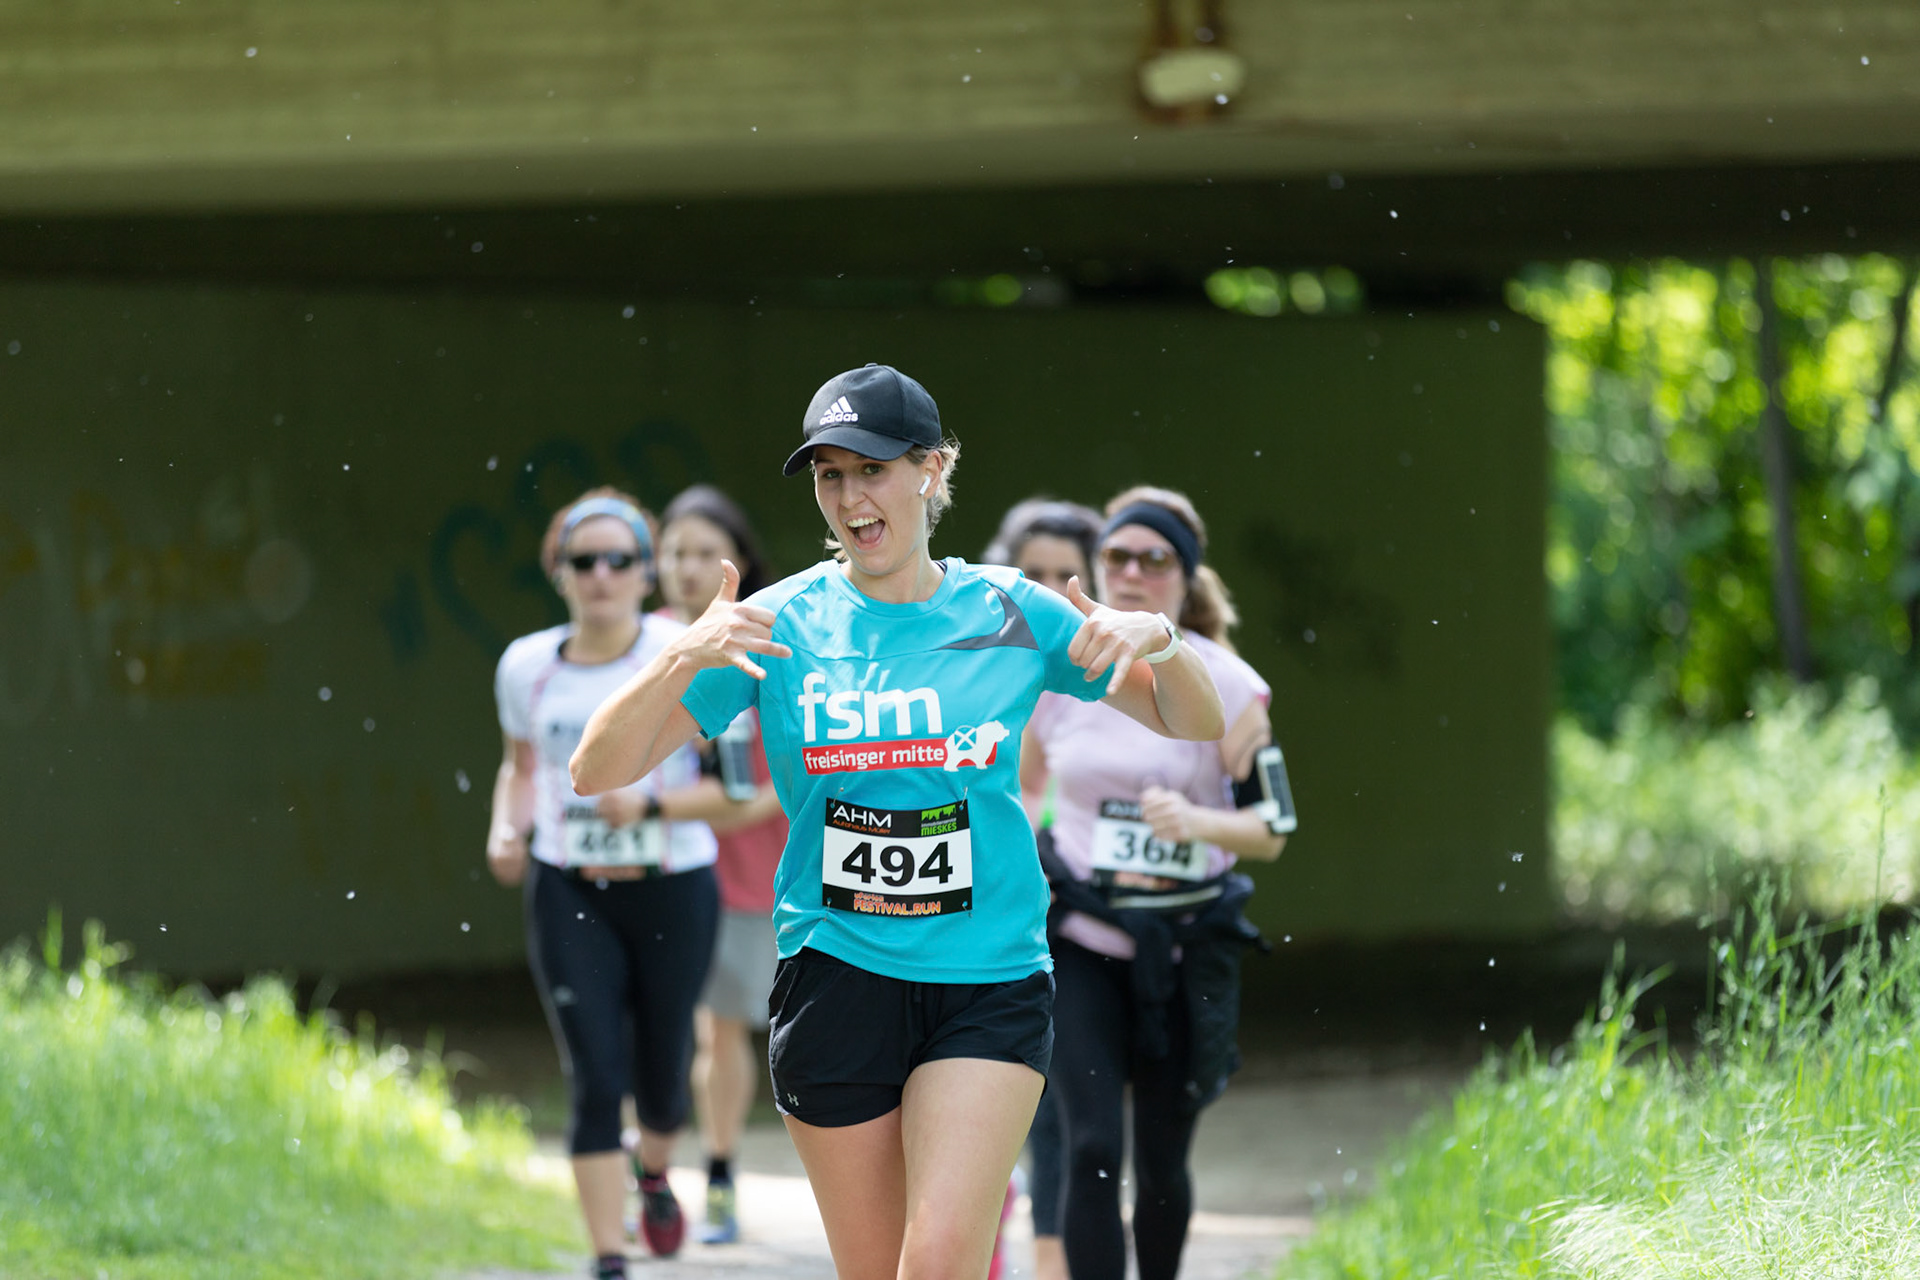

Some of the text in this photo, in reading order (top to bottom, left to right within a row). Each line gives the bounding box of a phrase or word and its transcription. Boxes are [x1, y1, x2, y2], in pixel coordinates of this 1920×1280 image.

[819, 411, 859, 425] adidas
[797, 671, 943, 743] fsm
[804, 745, 945, 771] freisinger mitte
[833, 804, 892, 829] AHM
[920, 821, 958, 837] MIESKES
[1113, 830, 1193, 867] 364
[841, 840, 954, 888] 494
[853, 898, 942, 916] FESTIVAL.RUN
